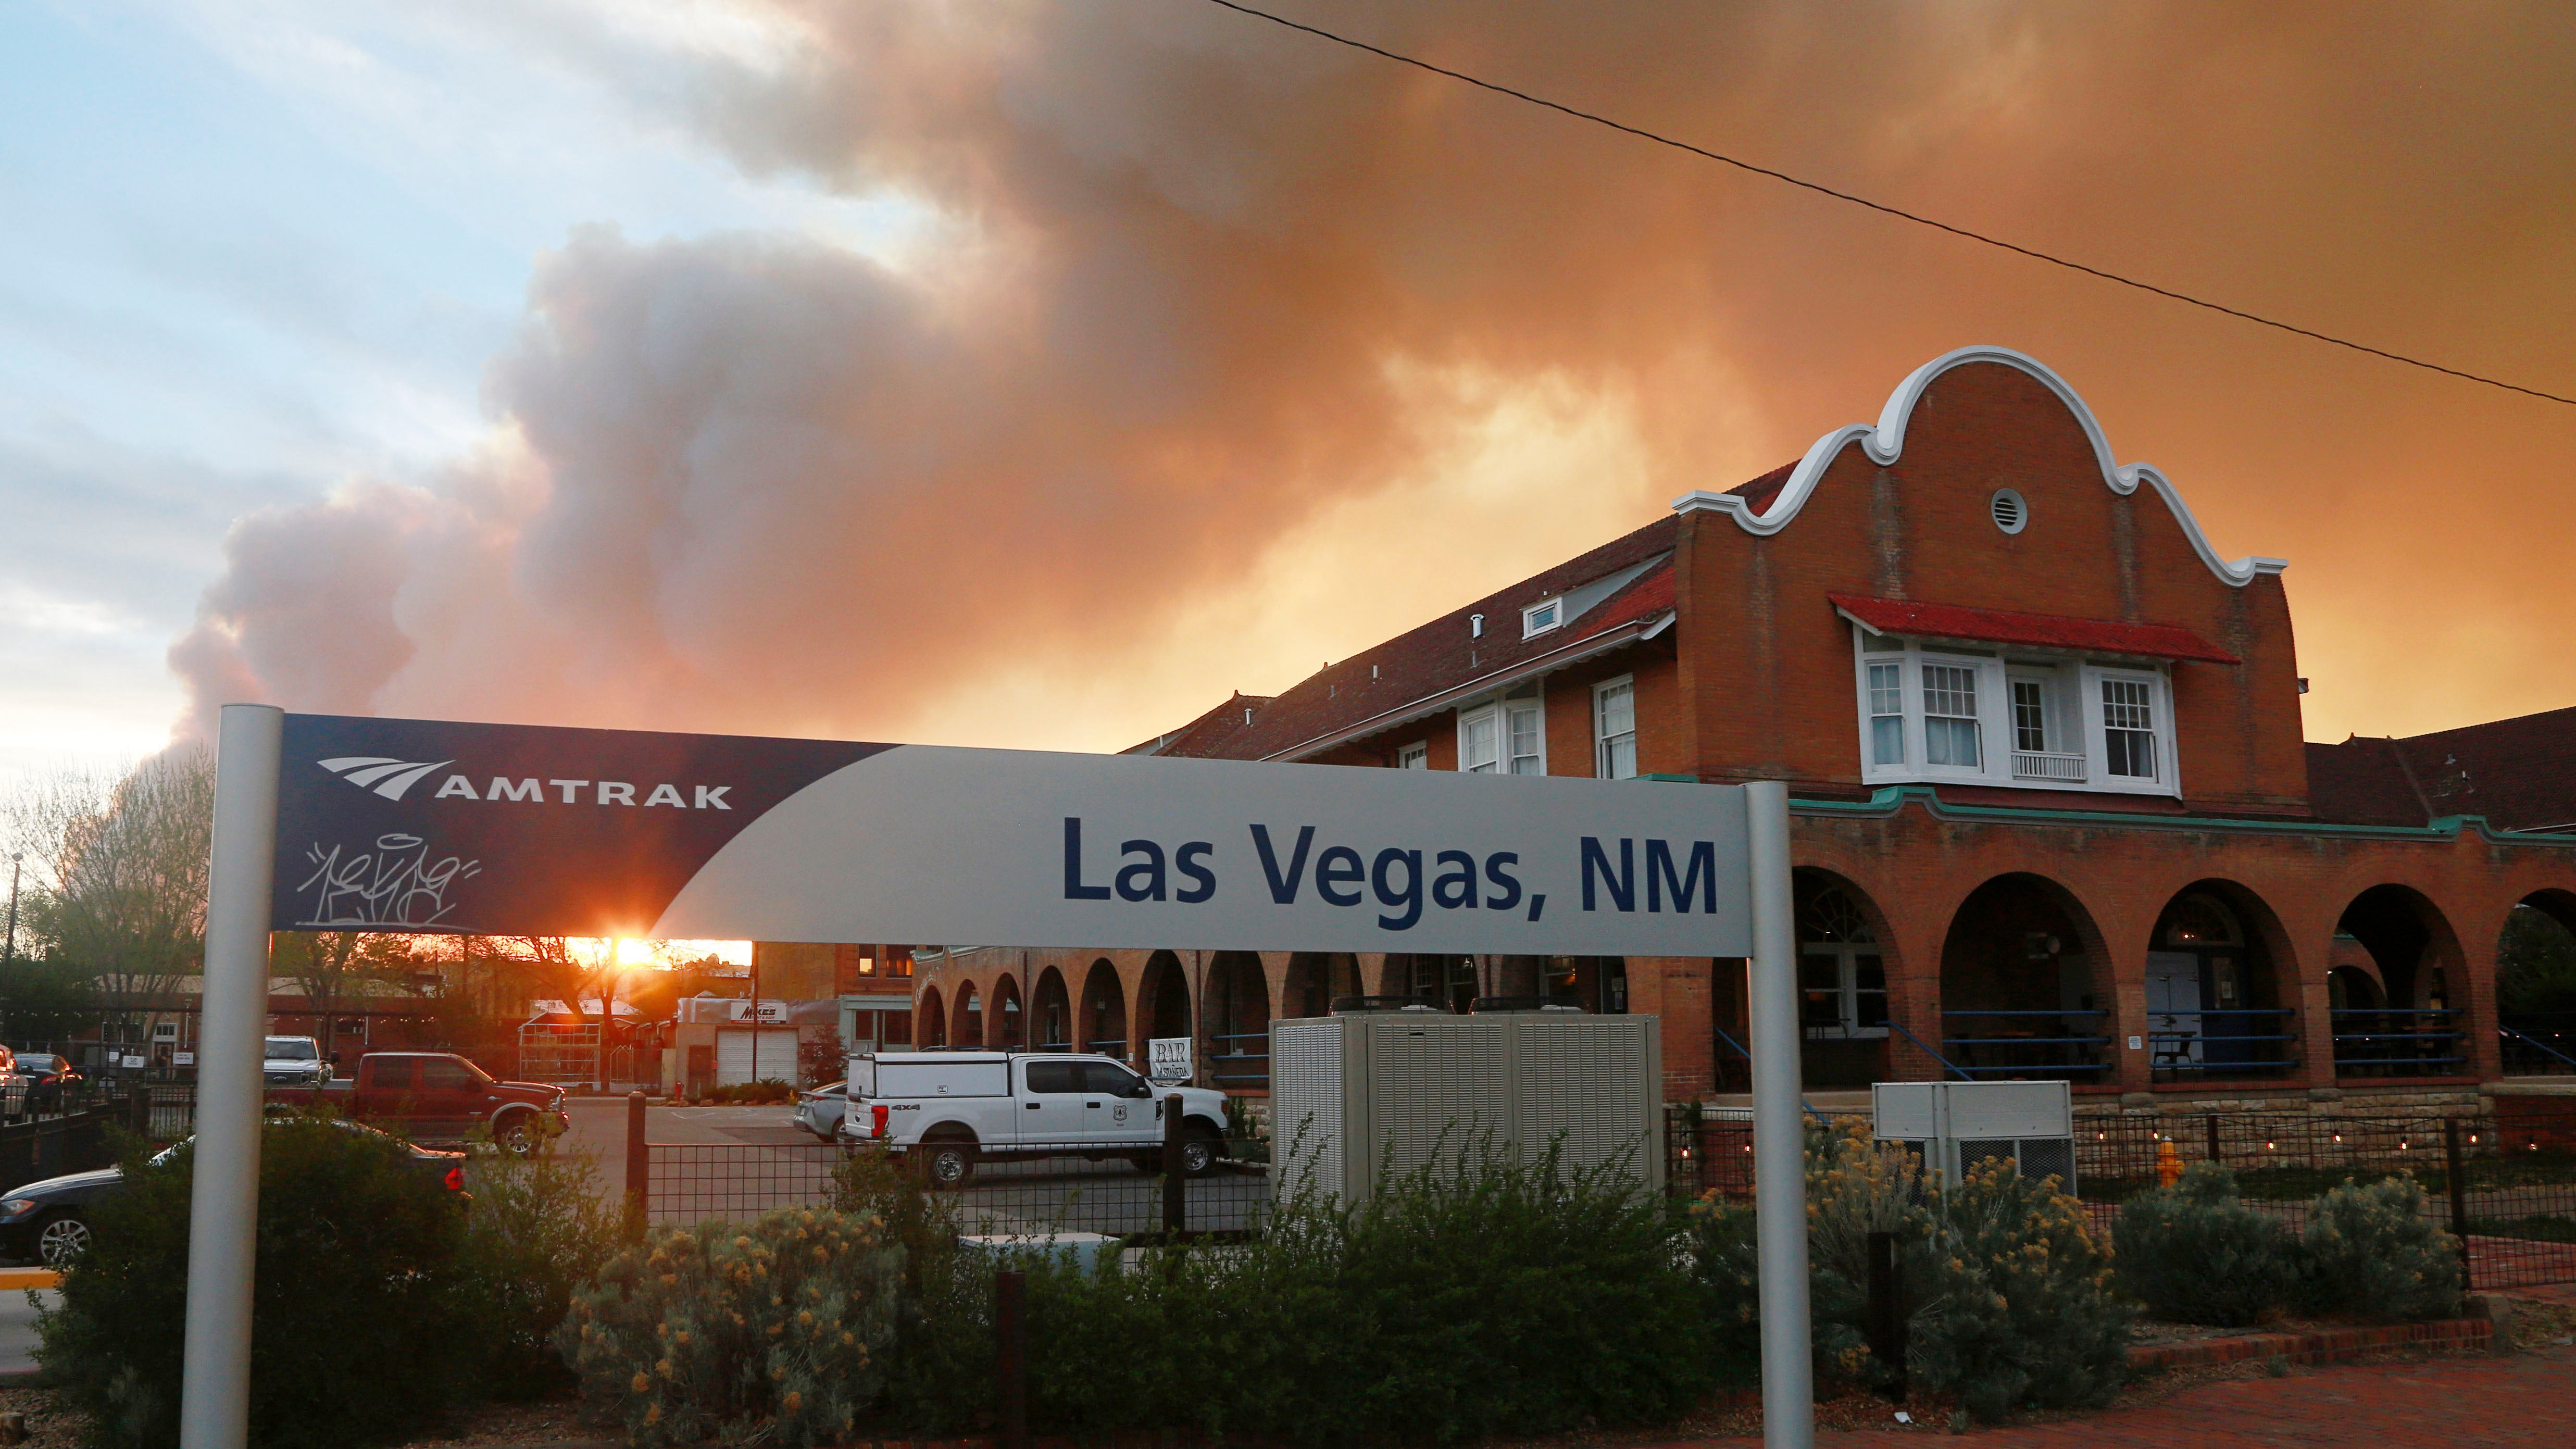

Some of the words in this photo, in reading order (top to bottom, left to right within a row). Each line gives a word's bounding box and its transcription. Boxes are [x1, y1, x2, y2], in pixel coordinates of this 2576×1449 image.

[434, 775, 733, 810] AMTRAK
[1064, 817, 1217, 904] Las
[1249, 823, 1546, 931] Vegas,
[1580, 836, 1718, 914] NM
[740, 1006, 776, 1019] MKES
[1154, 1043, 1185, 1063] BAR
